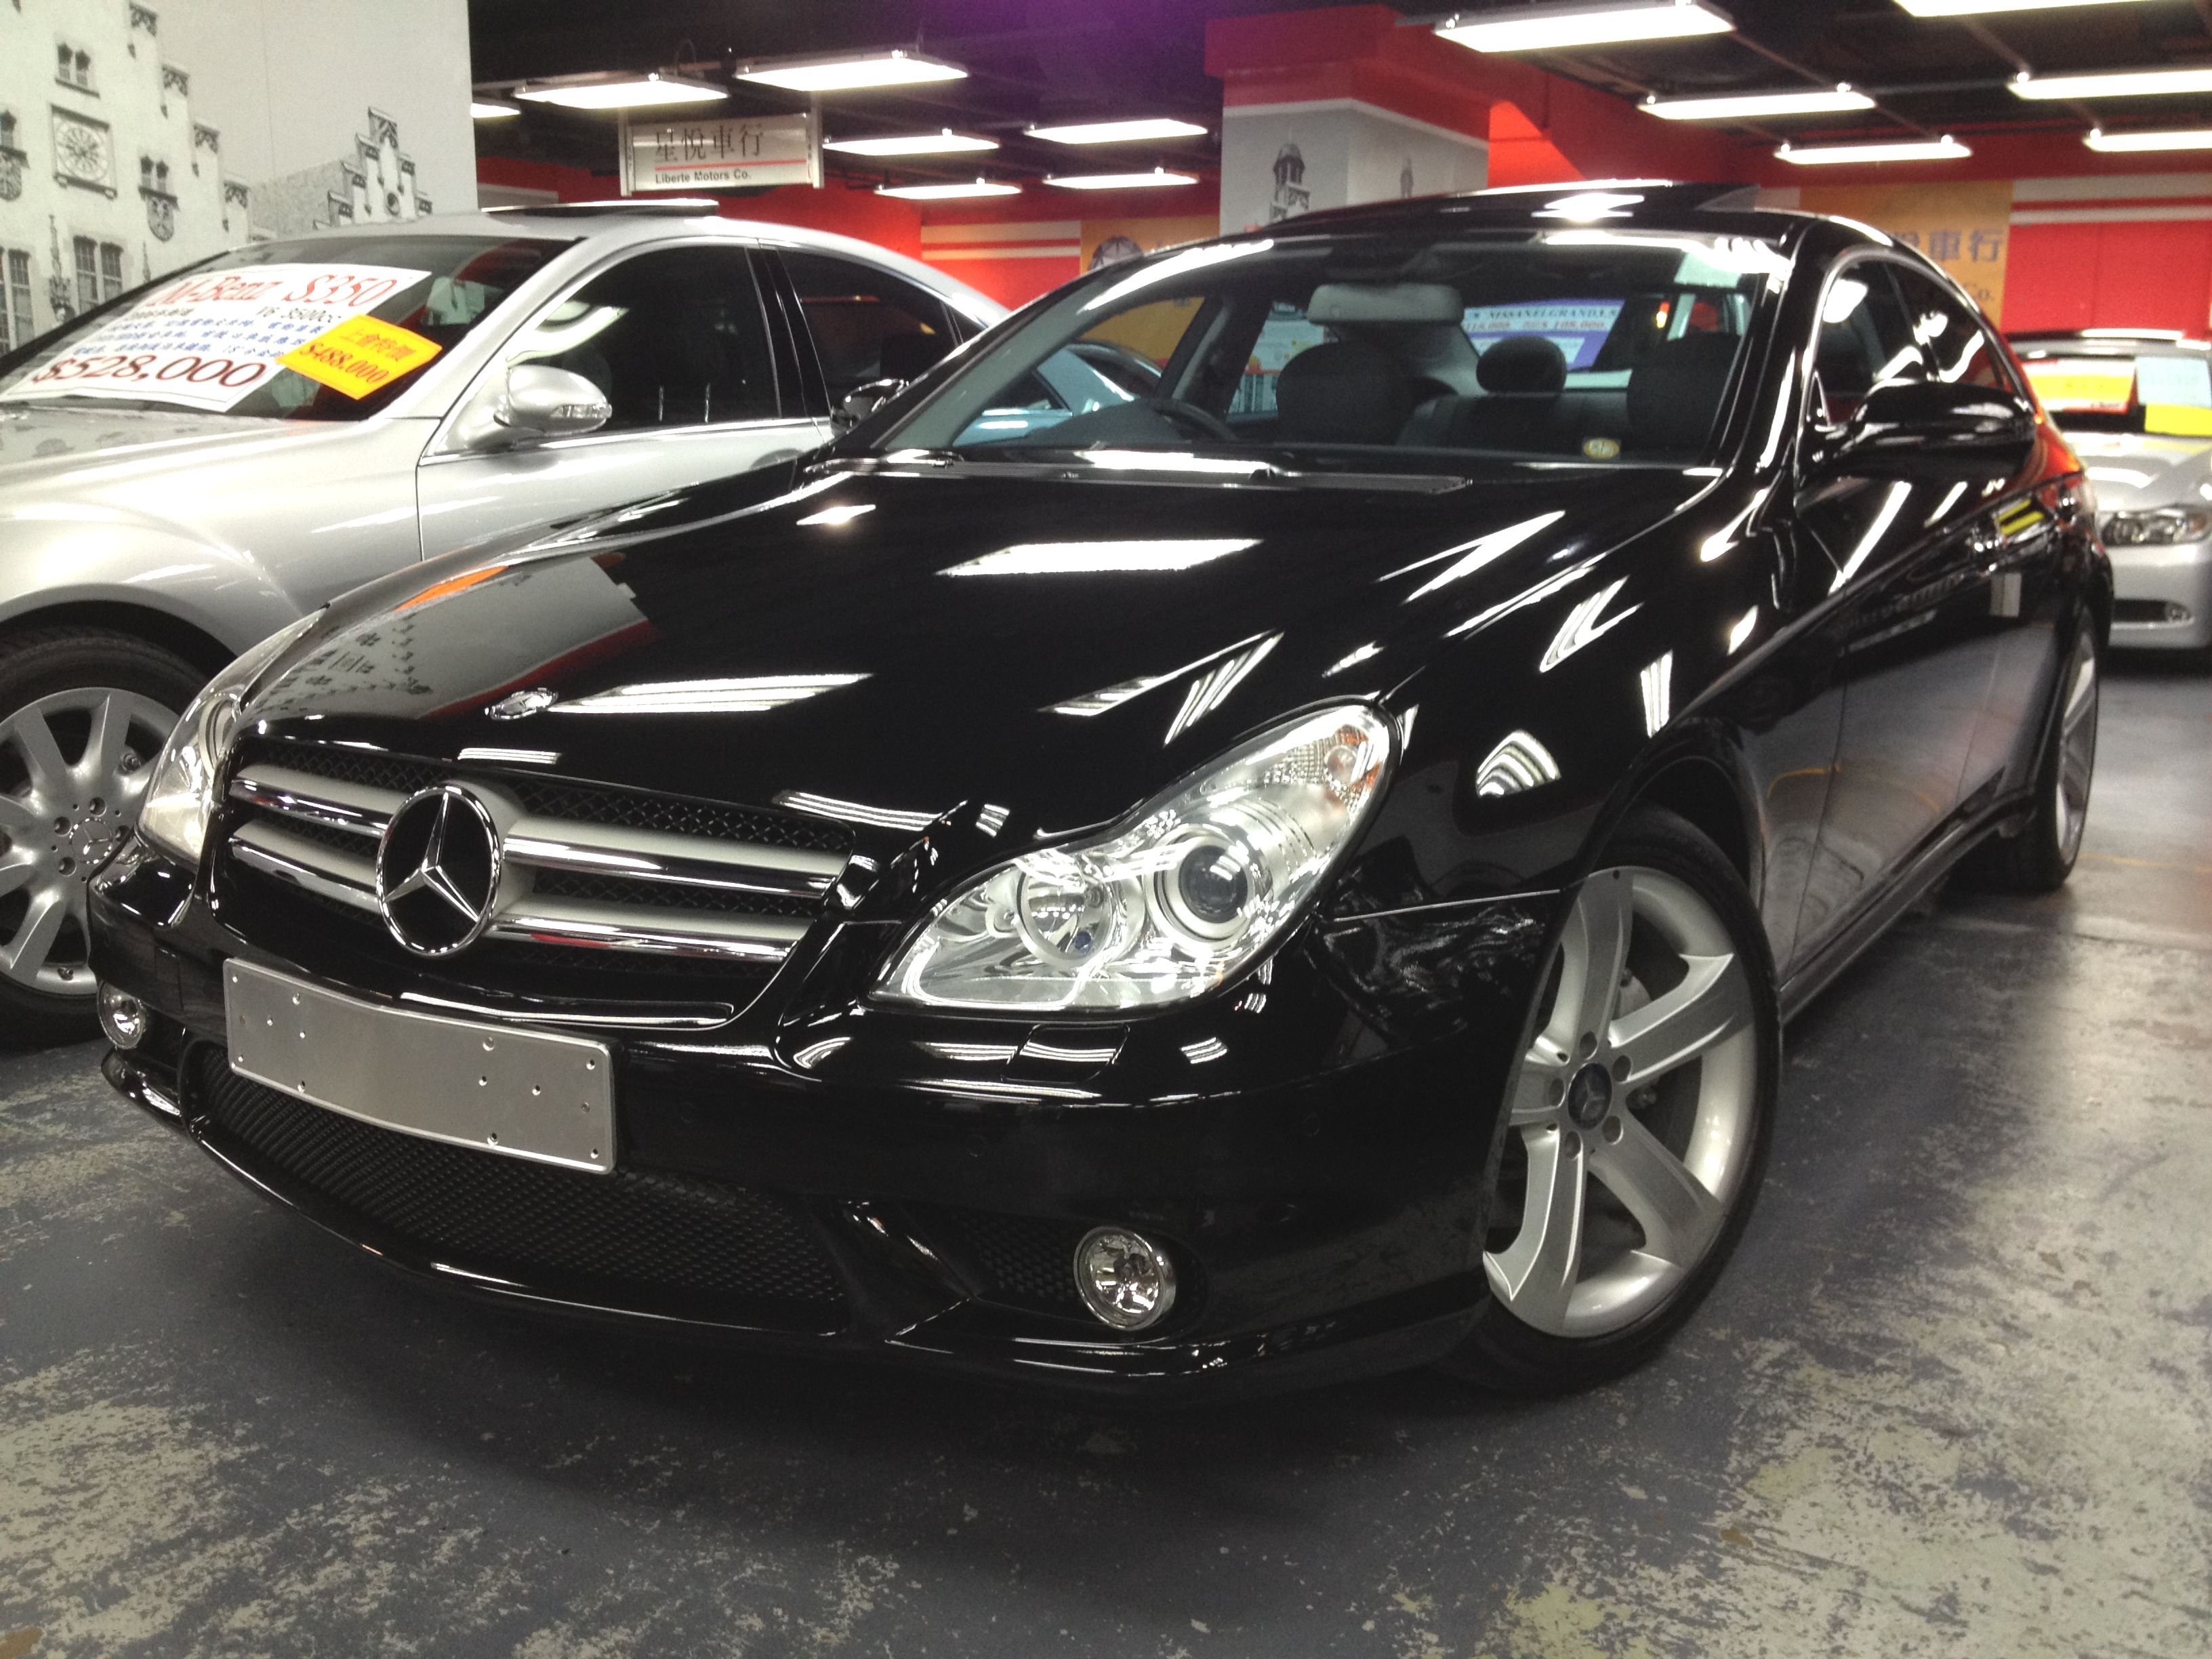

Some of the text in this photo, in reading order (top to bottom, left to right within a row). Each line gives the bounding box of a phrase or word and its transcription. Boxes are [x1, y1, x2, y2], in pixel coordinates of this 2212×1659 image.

[655, 169, 752, 184] Liberte Motors Co.
[281, 273, 398, 307] S350
[33, 354, 266, 387] $528,000
